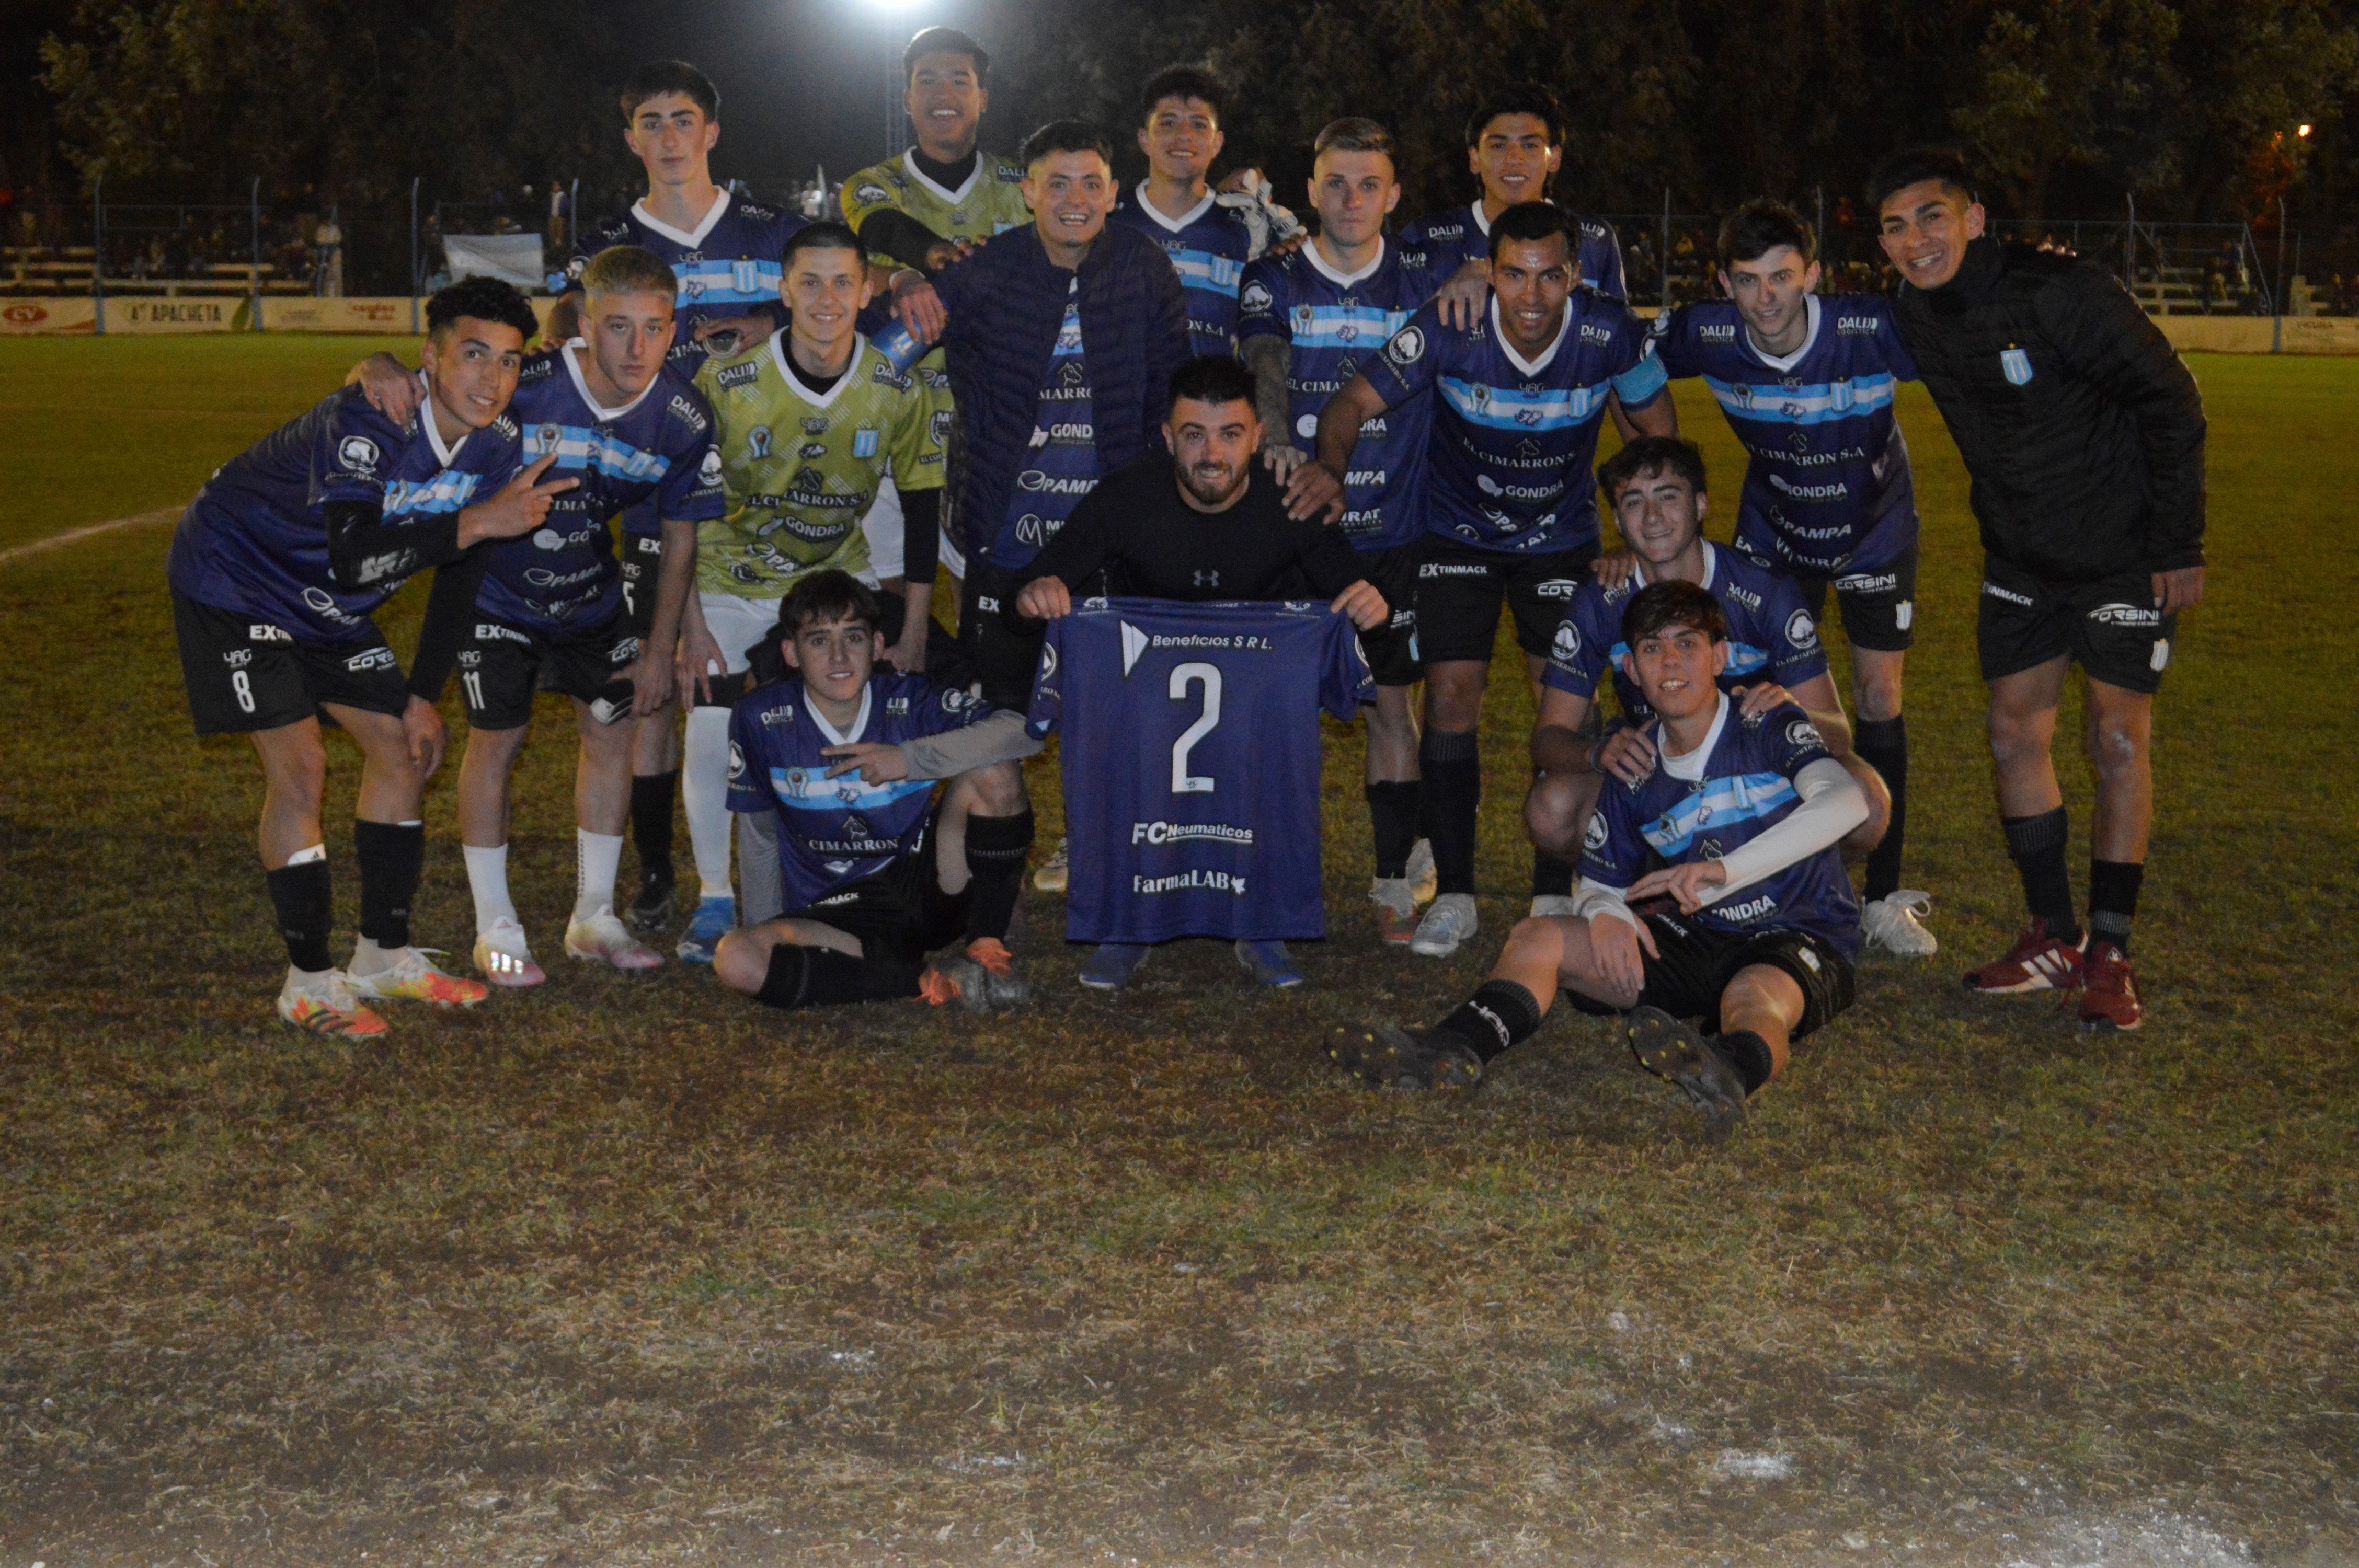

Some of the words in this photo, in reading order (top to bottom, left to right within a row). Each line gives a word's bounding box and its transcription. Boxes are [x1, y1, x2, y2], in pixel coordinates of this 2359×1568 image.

[1050, 424, 1093, 438] GOND
[1344, 471, 1386, 485] MPA
[1505, 479, 1564, 499] GONDRA
[785, 516, 845, 537] GONDRA
[1152, 634, 1229, 648] Beneficios
[232, 670, 256, 713] 8
[463, 671, 485, 710] 11
[1169, 662, 1222, 793] 2
[809, 838, 900, 851] CIMARRON
[1133, 870, 1229, 893] FarmaLAB
